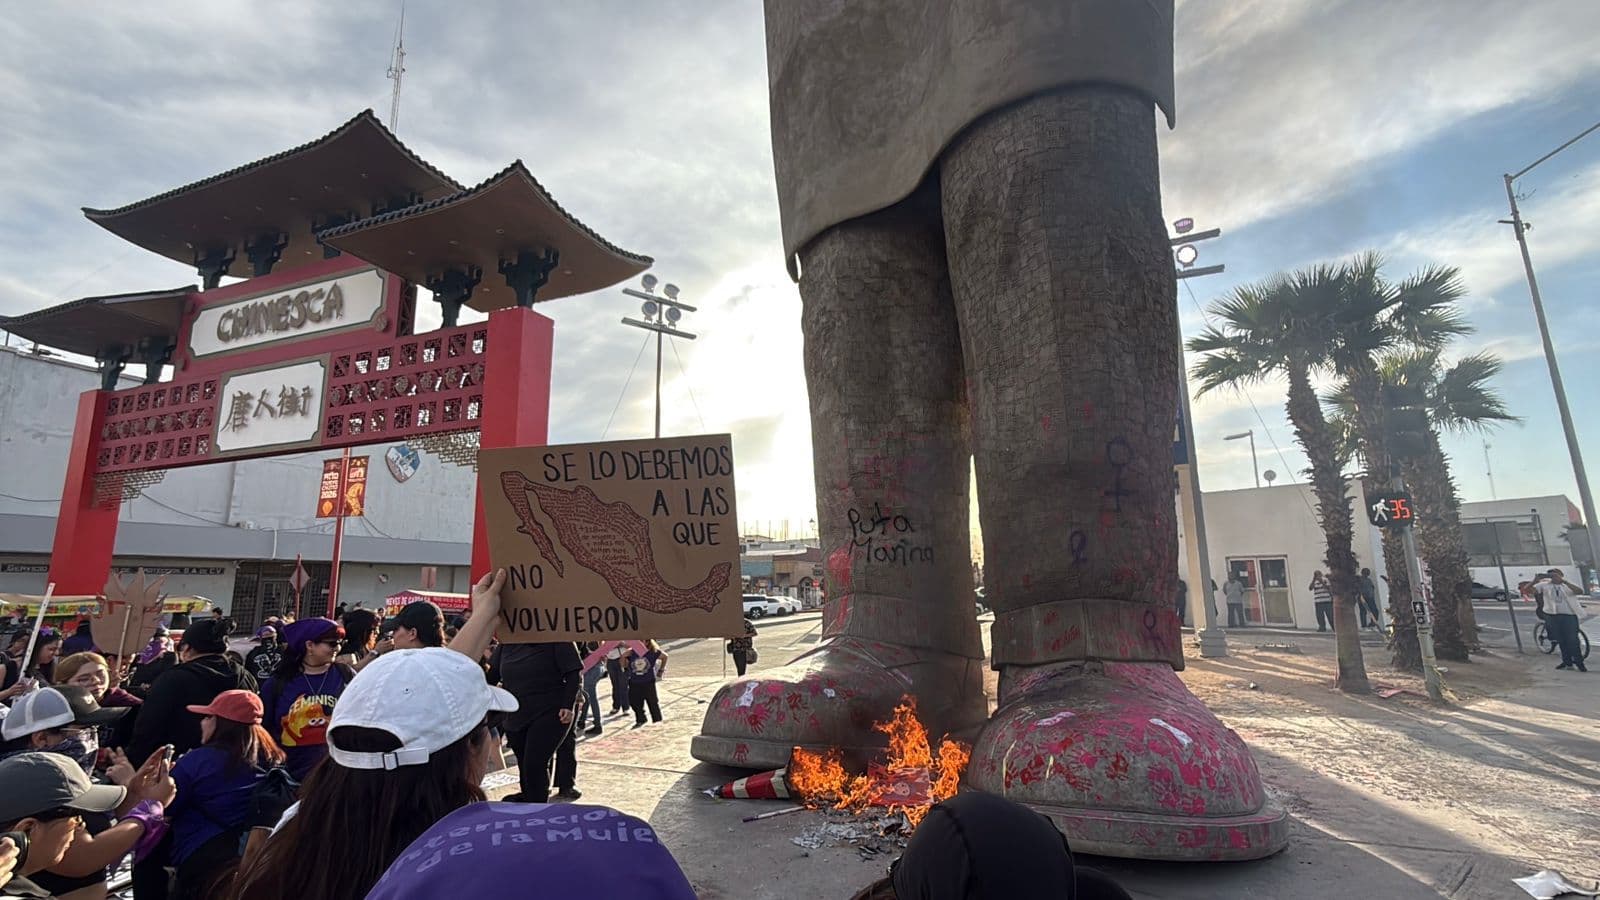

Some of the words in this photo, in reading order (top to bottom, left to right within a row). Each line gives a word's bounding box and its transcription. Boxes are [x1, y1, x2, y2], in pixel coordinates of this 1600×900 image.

[216, 281, 344, 343] CHINESCA
[220, 384, 313, 433] 唐人街
[543, 452, 578, 483] SE
[589, 450, 616, 481] LO
[622, 445, 732, 481] DEBEMOS
[652, 489, 670, 517] A
[685, 487, 730, 517] LAS
[1389, 498, 1411, 520] 35
[673, 522, 721, 546] QUE
[847, 501, 915, 538] Puta
[847, 536, 935, 567] Marina
[510, 564, 544, 591] NO
[503, 606, 639, 634] VOLVIERON
[416, 842, 474, 873] de
[492, 832, 535, 847] la
